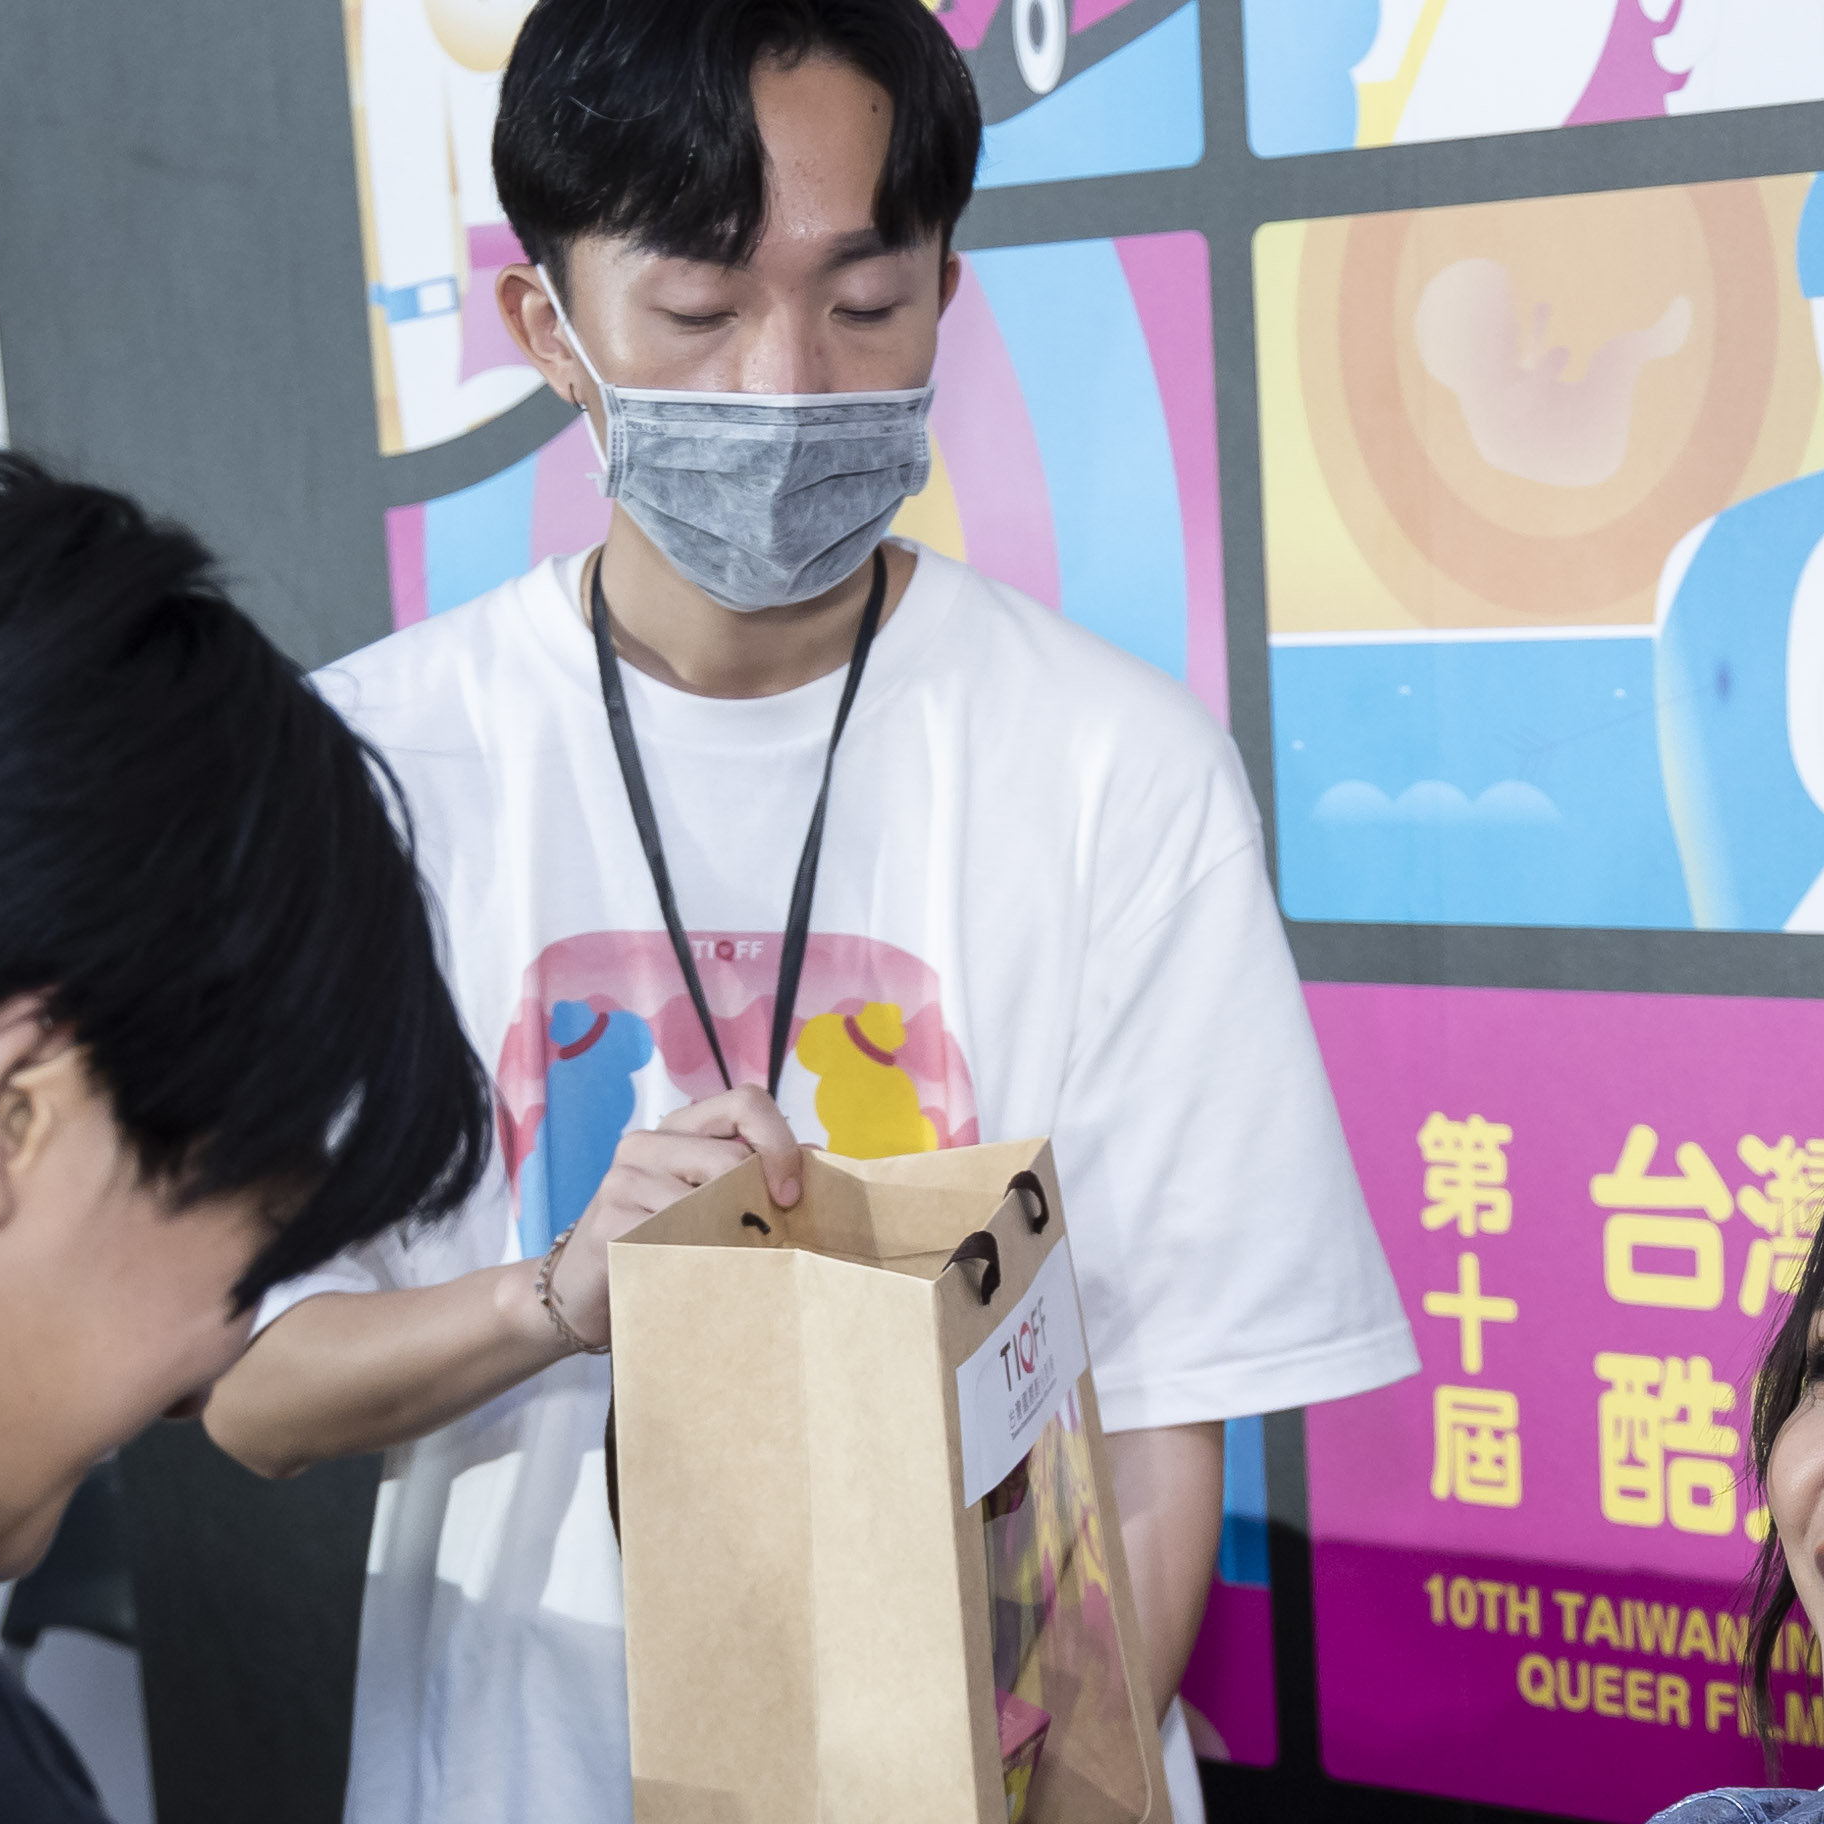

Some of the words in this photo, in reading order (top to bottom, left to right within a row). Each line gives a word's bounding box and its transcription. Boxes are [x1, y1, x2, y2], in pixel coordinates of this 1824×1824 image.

[1416, 1111, 1523, 1509] 第十屆
[1594, 1352, 1773, 1544] 酷
[1424, 1574, 1541, 1637] 10TH
[1554, 1592, 1751, 1665] TAIWAN
[1518, 1654, 1690, 1729] QUEER
